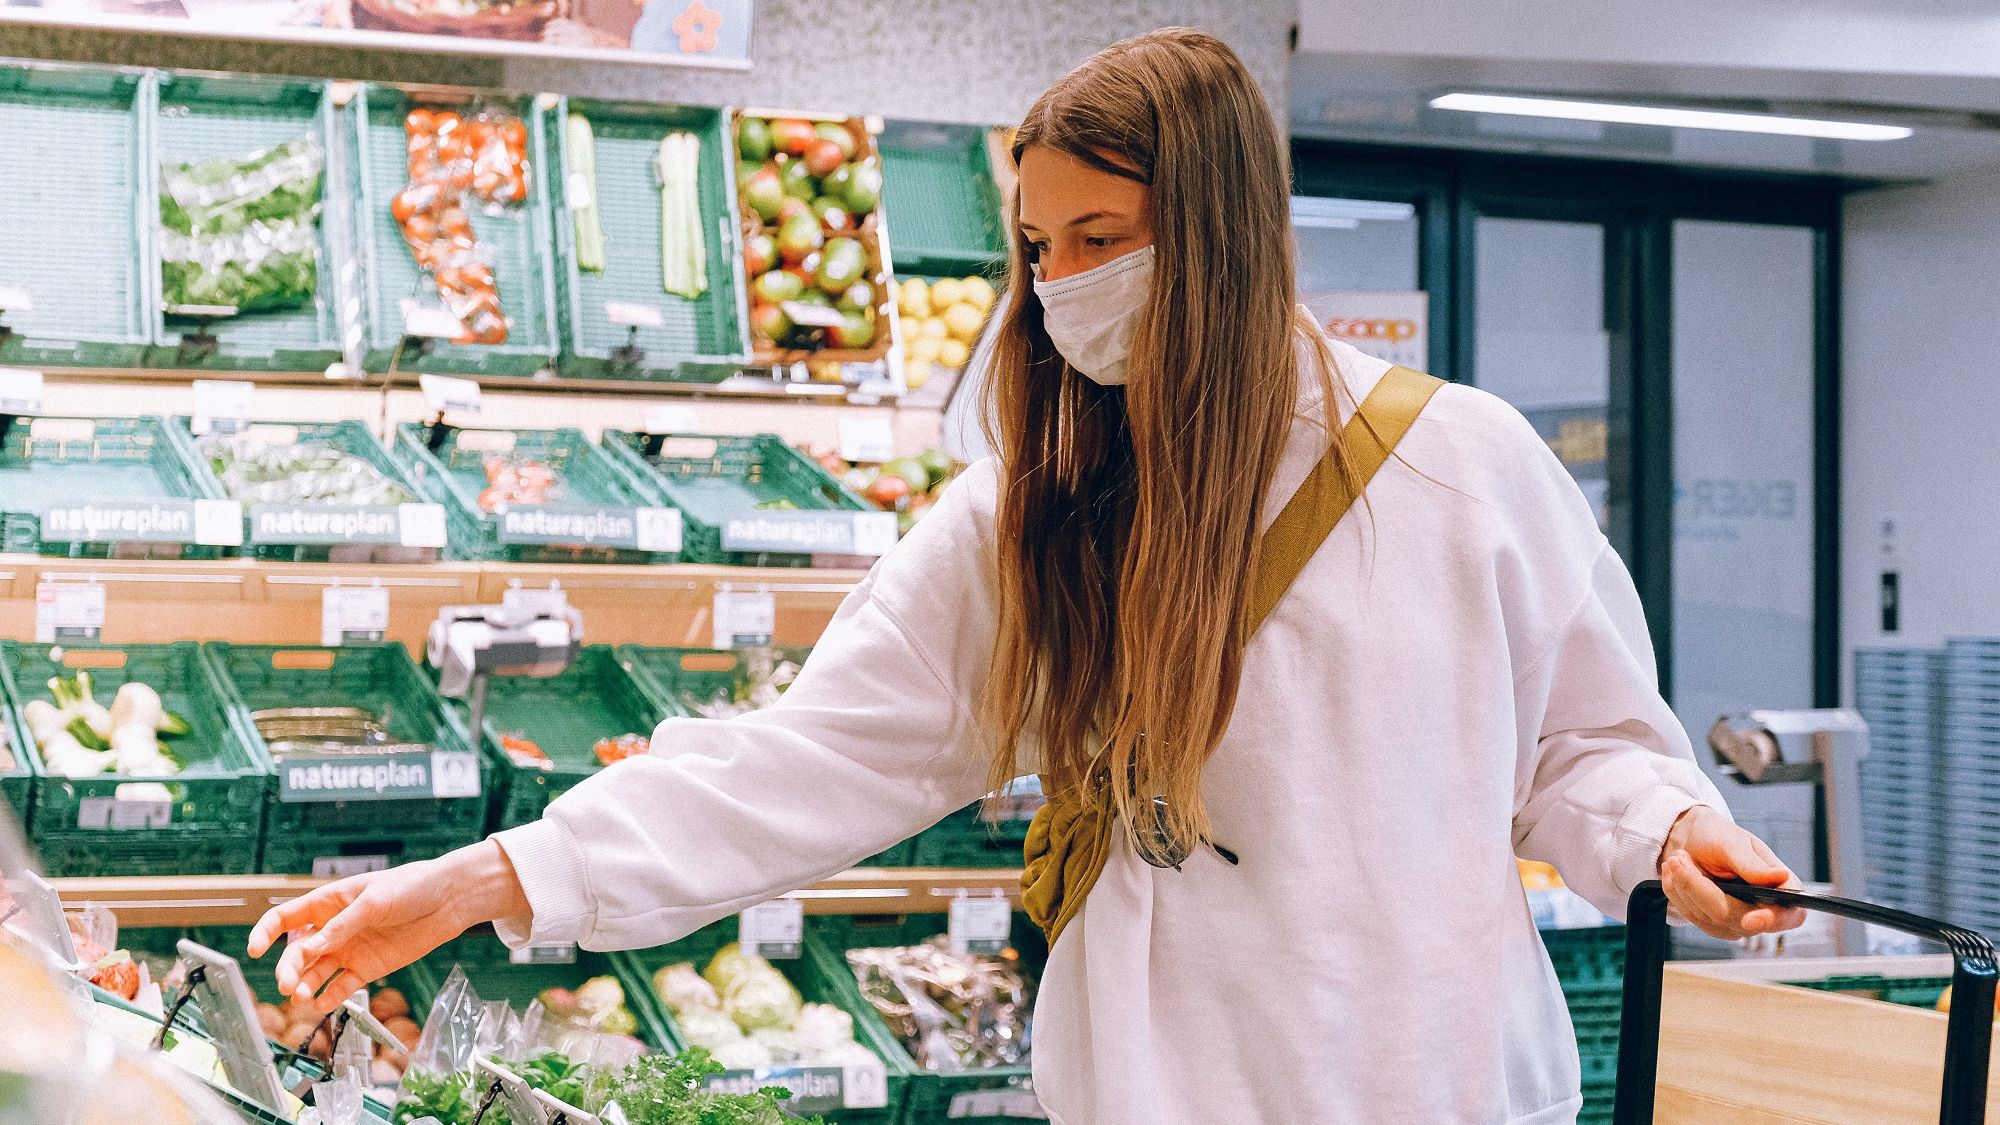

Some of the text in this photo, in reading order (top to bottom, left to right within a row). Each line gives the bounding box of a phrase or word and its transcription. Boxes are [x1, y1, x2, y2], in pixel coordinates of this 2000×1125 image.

[1327, 317, 1418, 344] coop
[49, 504, 189, 537] naturaplan
[260, 509, 395, 539] naturaplan
[505, 509, 633, 542] naturaplan
[288, 760, 427, 792] naturaplan
